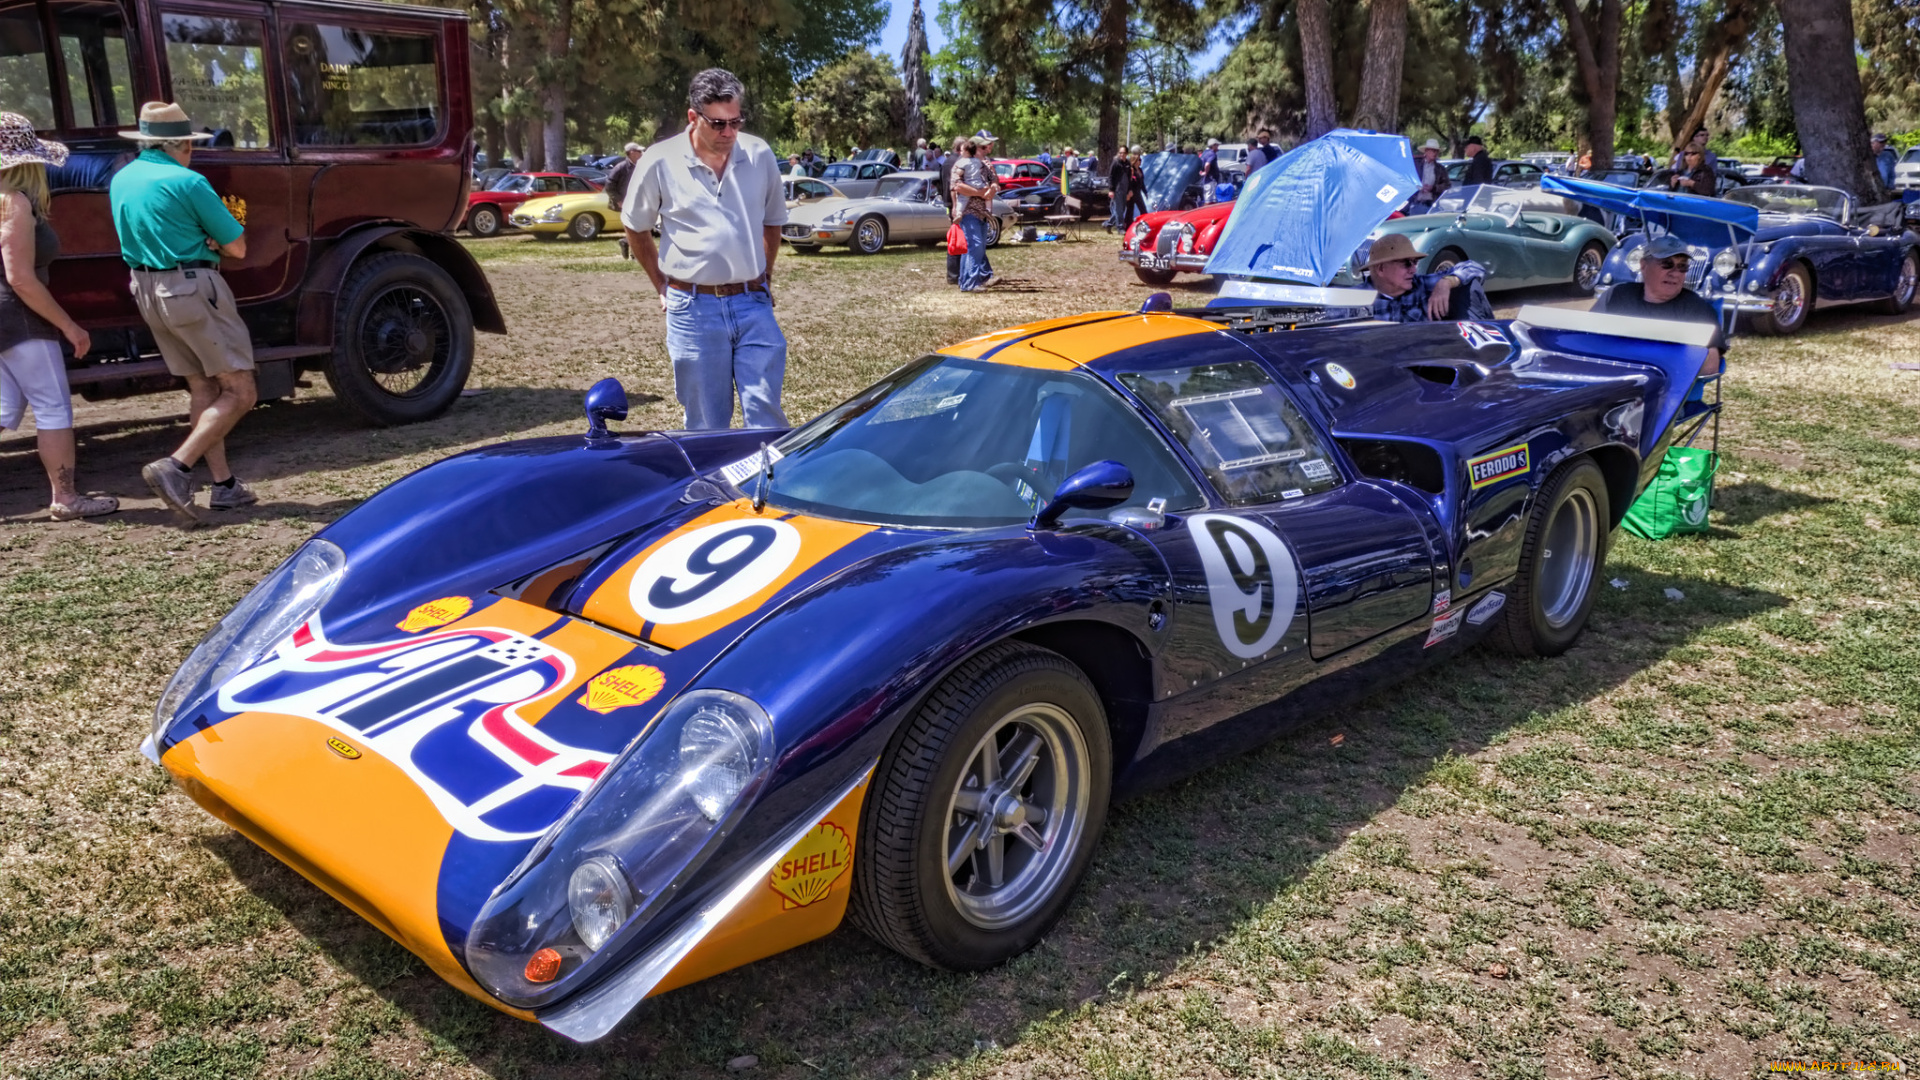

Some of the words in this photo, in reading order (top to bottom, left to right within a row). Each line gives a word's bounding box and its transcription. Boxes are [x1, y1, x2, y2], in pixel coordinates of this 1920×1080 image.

[1472, 454, 1517, 481] FERODO
[647, 524, 777, 610] 9
[1205, 519, 1275, 646] 9
[418, 605, 454, 622] SHELL
[1430, 616, 1461, 638] CHAMPION
[599, 674, 647, 700] SHELL
[780, 849, 842, 881] SHELL
